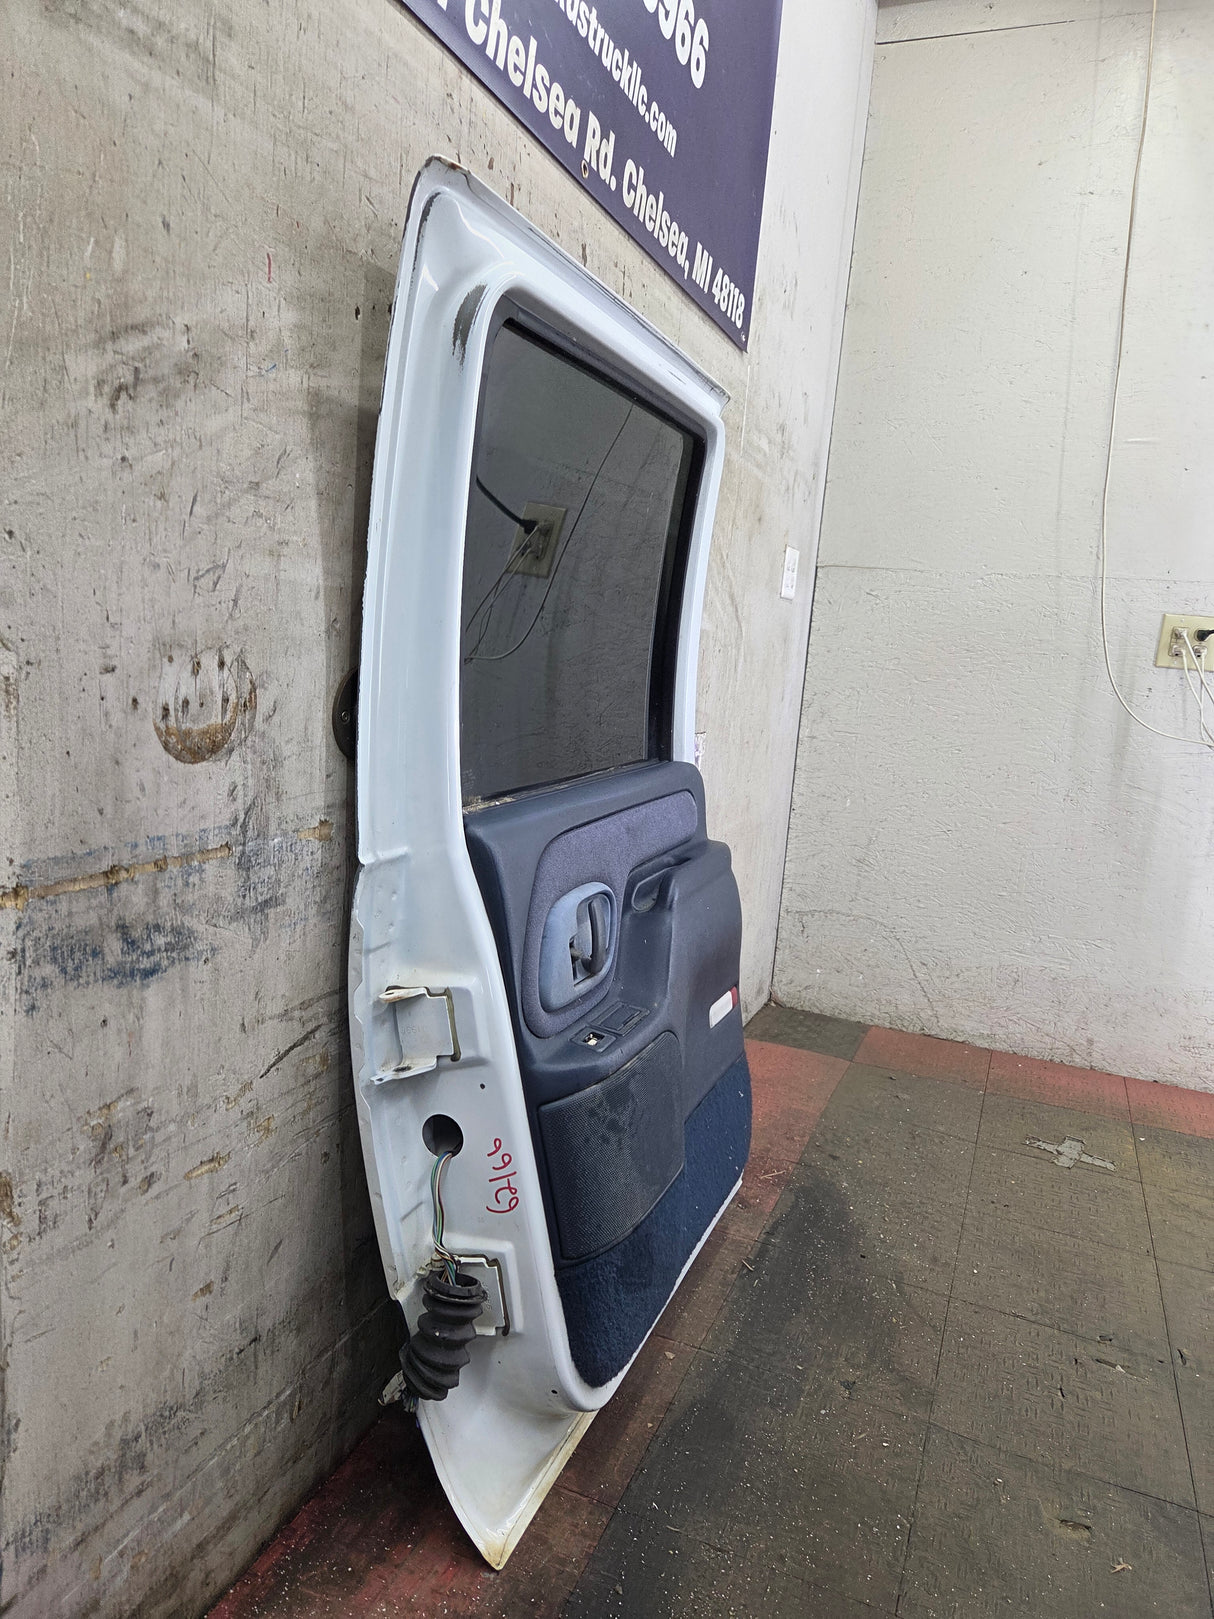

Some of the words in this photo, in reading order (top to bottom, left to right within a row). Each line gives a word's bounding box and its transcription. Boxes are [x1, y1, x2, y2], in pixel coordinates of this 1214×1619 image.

[642, 0, 710, 89] 966
[464, 0, 581, 149] Chelsea
[583, 110, 617, 192] Rd.
[622, 158, 690, 280] Chelsea,
[691, 241, 713, 294] MI
[711, 267, 746, 329] 48118
